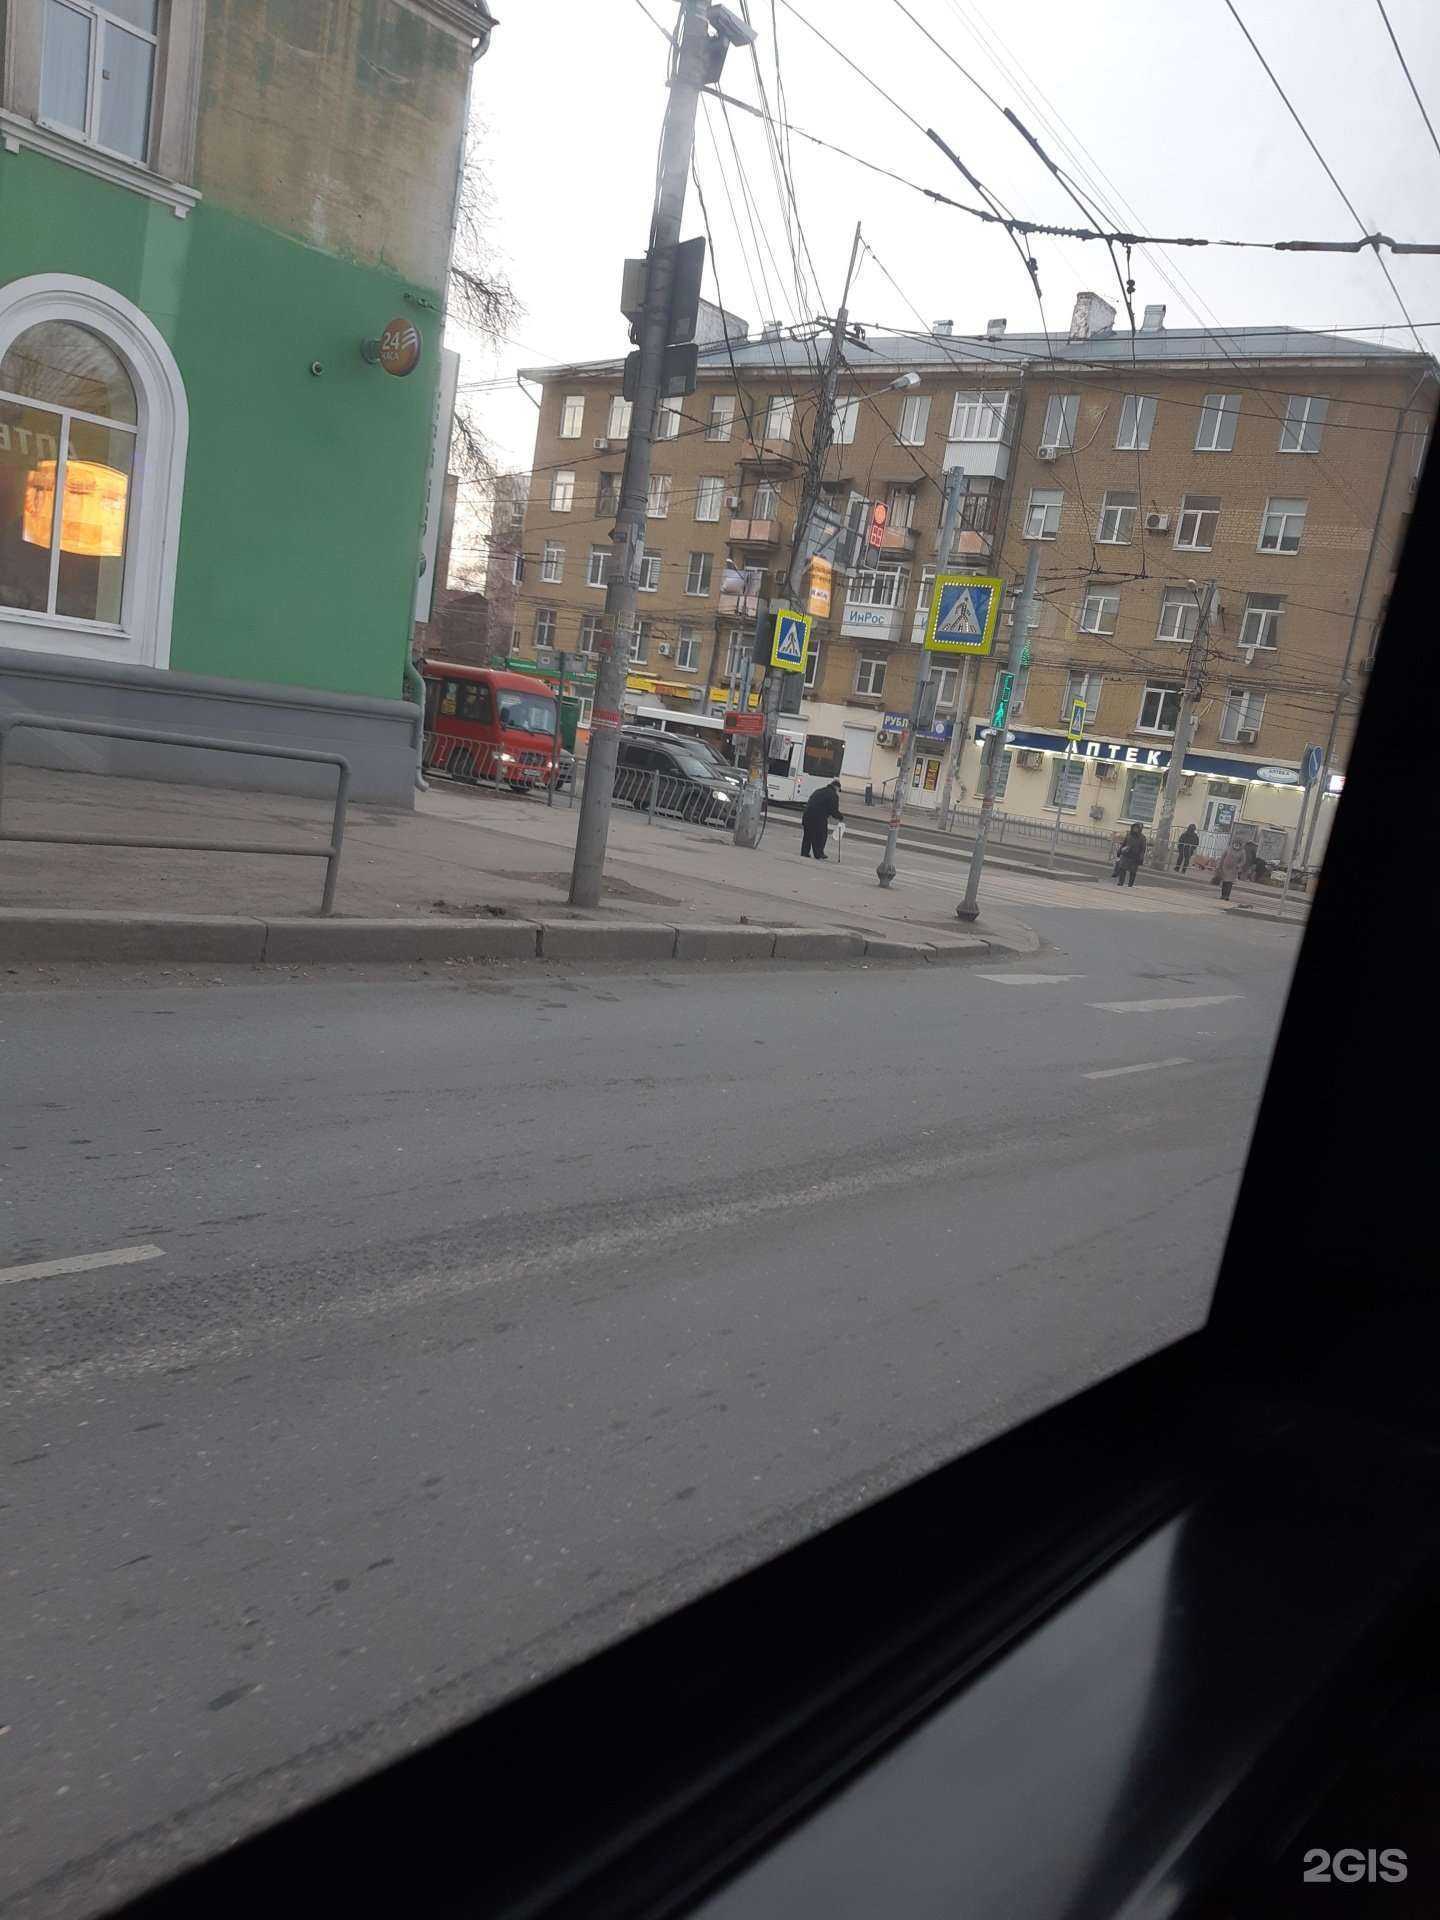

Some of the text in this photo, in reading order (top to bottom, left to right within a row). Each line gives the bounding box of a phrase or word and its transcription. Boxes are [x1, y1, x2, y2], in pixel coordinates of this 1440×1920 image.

[382, 331, 400, 350] 24
[849, 610, 885, 625] ИнРос
[1065, 740, 1172, 768] АПТЕК
